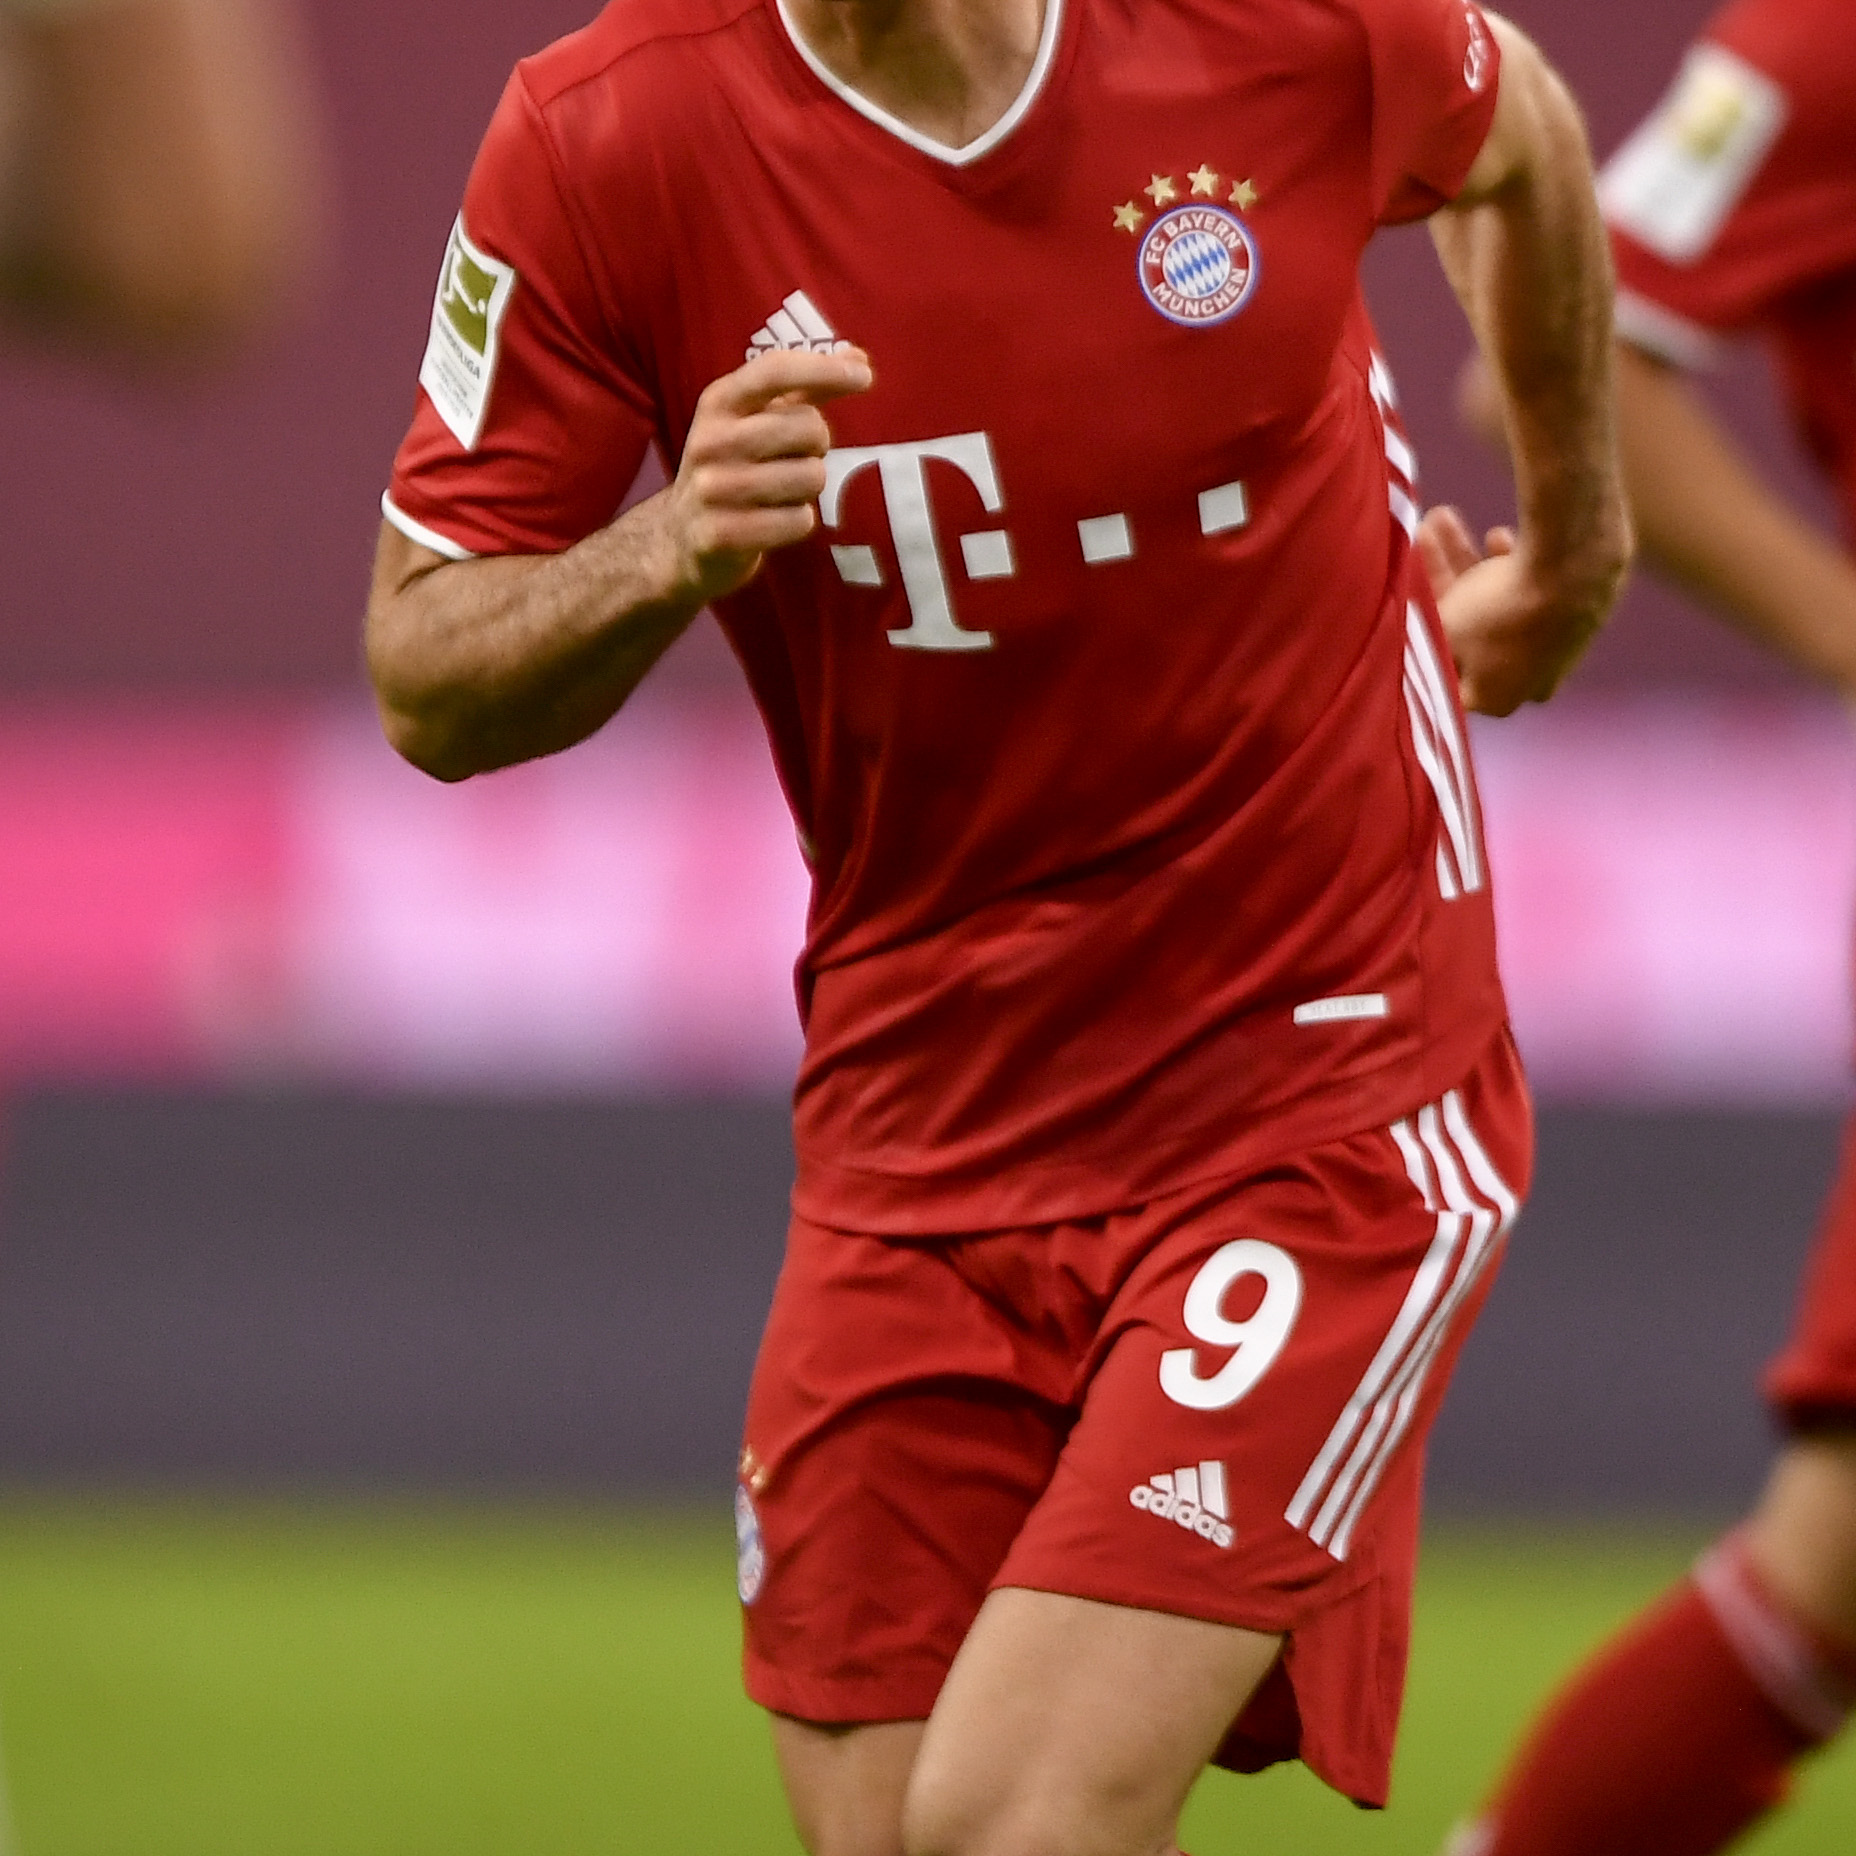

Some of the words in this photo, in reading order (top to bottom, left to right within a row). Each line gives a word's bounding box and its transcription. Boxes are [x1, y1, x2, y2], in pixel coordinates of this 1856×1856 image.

[1146, 237, 1165, 264] FC
[1162, 213, 1241, 248] BAYERN
[1159, 1239, 1301, 1410] 9
[1129, 1485, 1235, 1548] adidas
